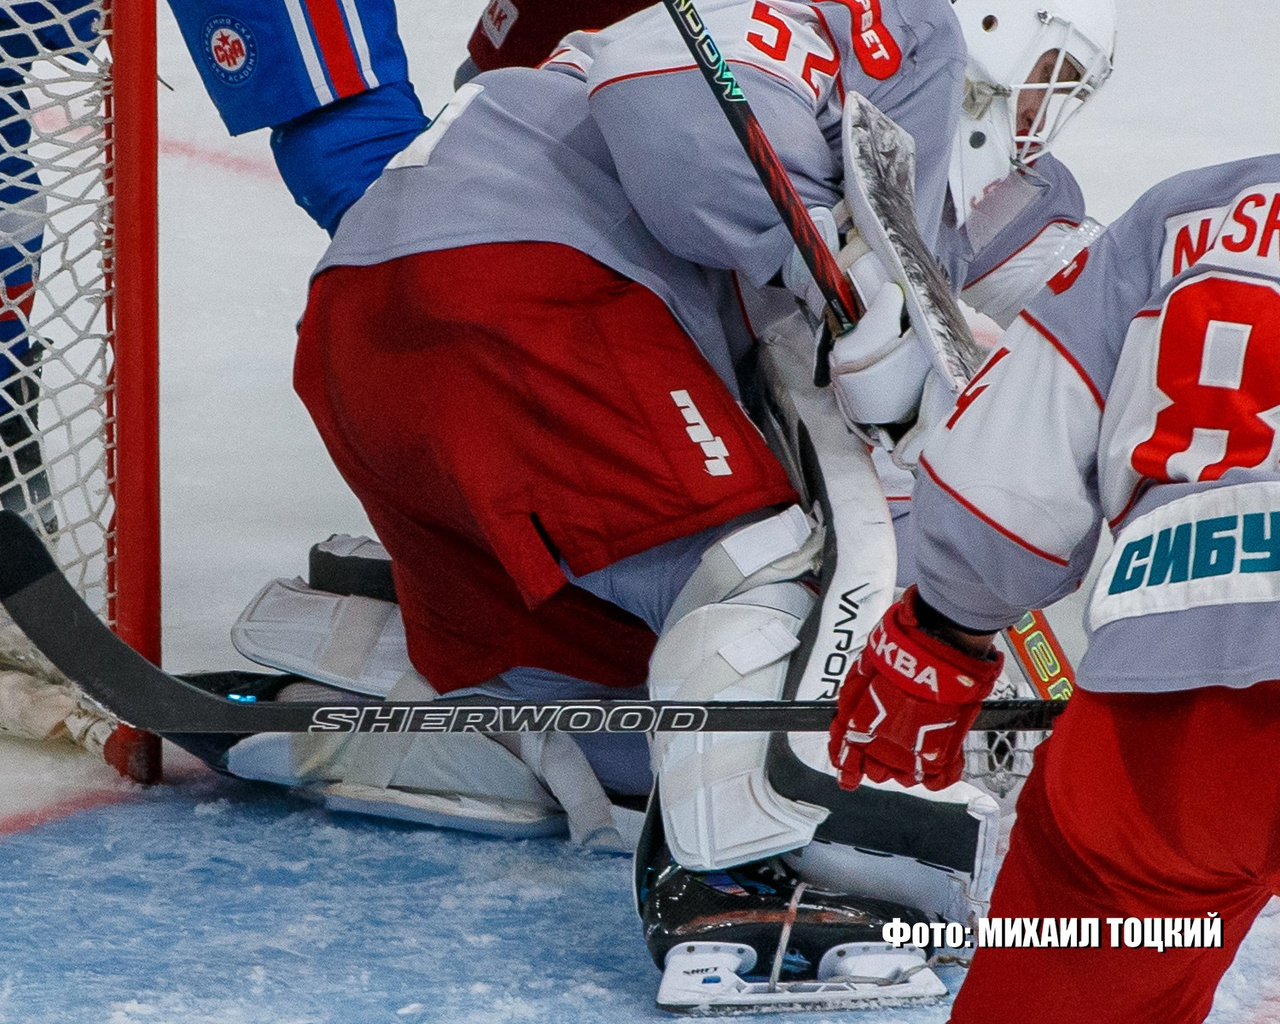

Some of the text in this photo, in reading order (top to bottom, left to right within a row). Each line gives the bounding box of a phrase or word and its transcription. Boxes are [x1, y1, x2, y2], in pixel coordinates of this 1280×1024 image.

[816, 582, 870, 701] VAPOR
[870, 629, 940, 693] КВА
[308, 705, 708, 734] SHERWOOD
